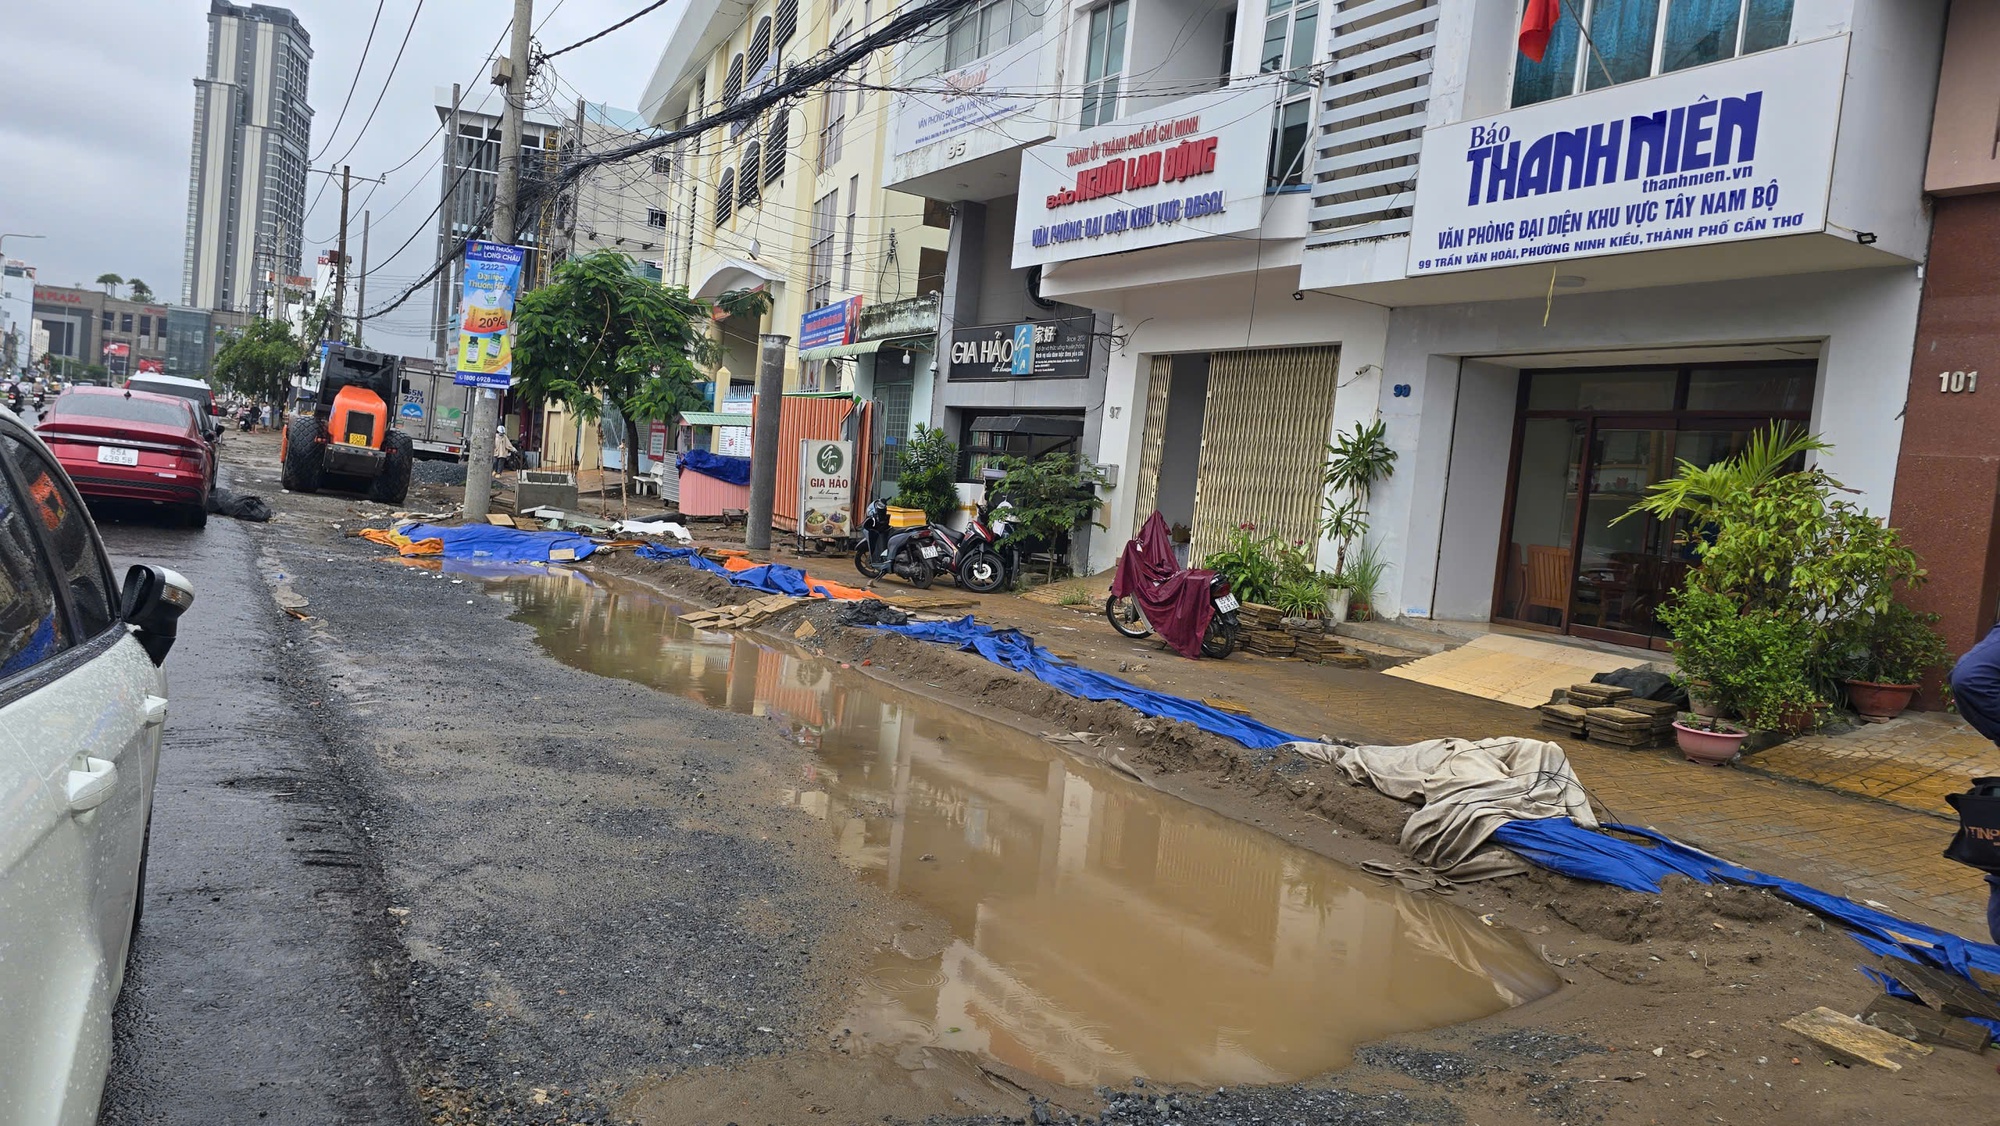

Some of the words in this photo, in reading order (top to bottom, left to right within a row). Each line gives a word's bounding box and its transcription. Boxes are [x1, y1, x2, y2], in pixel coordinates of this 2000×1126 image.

[1067, 147, 1089, 168] THÀNH
[1102, 137, 1127, 158] THÀNH
[1127, 125, 1145, 151] PHỐ
[1146, 122, 1158, 145] HỒ
[1158, 120, 1174, 142] CHÍ
[1175, 116, 1199, 137] MINH
[1469, 122, 1511, 149] Báo
[949, 142, 967, 159] 95
[1467, 119, 1624, 207] THANH
[1624, 90, 1763, 182] NIÊN
[1046, 186, 1076, 210] BÁO
[1125, 151, 1162, 191] LAO
[1163, 136, 1218, 183] ĐỘNG
[1642, 165, 1753, 193] thanhnien.vn
[1032, 225, 1050, 248] VĂN
[1050, 219, 1084, 245] PHÒNG
[1085, 215, 1104, 241] ĐẠI
[1104, 208, 1129, 236] DIỆN
[1130, 205, 1155, 230] KHU
[1157, 199, 1183, 227] VỰC
[1184, 190, 1226, 219] ĐBSCL
[1438, 227, 1465, 250] VĂN
[1467, 220, 1515, 246] PHÒNG
[1519, 218, 1545, 242] ĐẠI
[1547, 209, 1583, 237] DIỆN
[1586, 205, 1621, 231] KHU
[1626, 201, 1660, 228] VỰC
[1665, 192, 1697, 220] TÂY
[1700, 188, 1747, 216] NAM
[1752, 179, 1780, 212] BỘ
[495, 245, 514, 254] THUỐC
[1418, 260, 1432, 270] 99
[1466, 251, 1488, 265] VĂN
[1490, 247, 1519, 261] HOÀI,
[1520, 242, 1570, 258] PHƯỜNG
[1574, 238, 1606, 252] NINH
[1609, 232, 1643, 248] KIỀU,
[1646, 227, 1694, 243] THÀNH
[1698, 219, 1730, 238] PHỐ
[1733, 216, 1767, 233] CẦN
[1772, 212, 1805, 229] THƠ
[483, 251, 501, 259] LONG
[502, 253, 521, 262] CHÂU
[47, 291, 81, 304] PLAZA
[478, 316, 505, 329] 20%
[952, 341, 979, 364] GIA
[980, 330, 1014, 363] HẢO
[1393, 384, 1411, 398] 99
[1939, 371, 1978, 393] 101
[403, 394, 425, 404] 2274
[810, 478, 826, 488] GIA
[829, 475, 849, 488] HẢO
